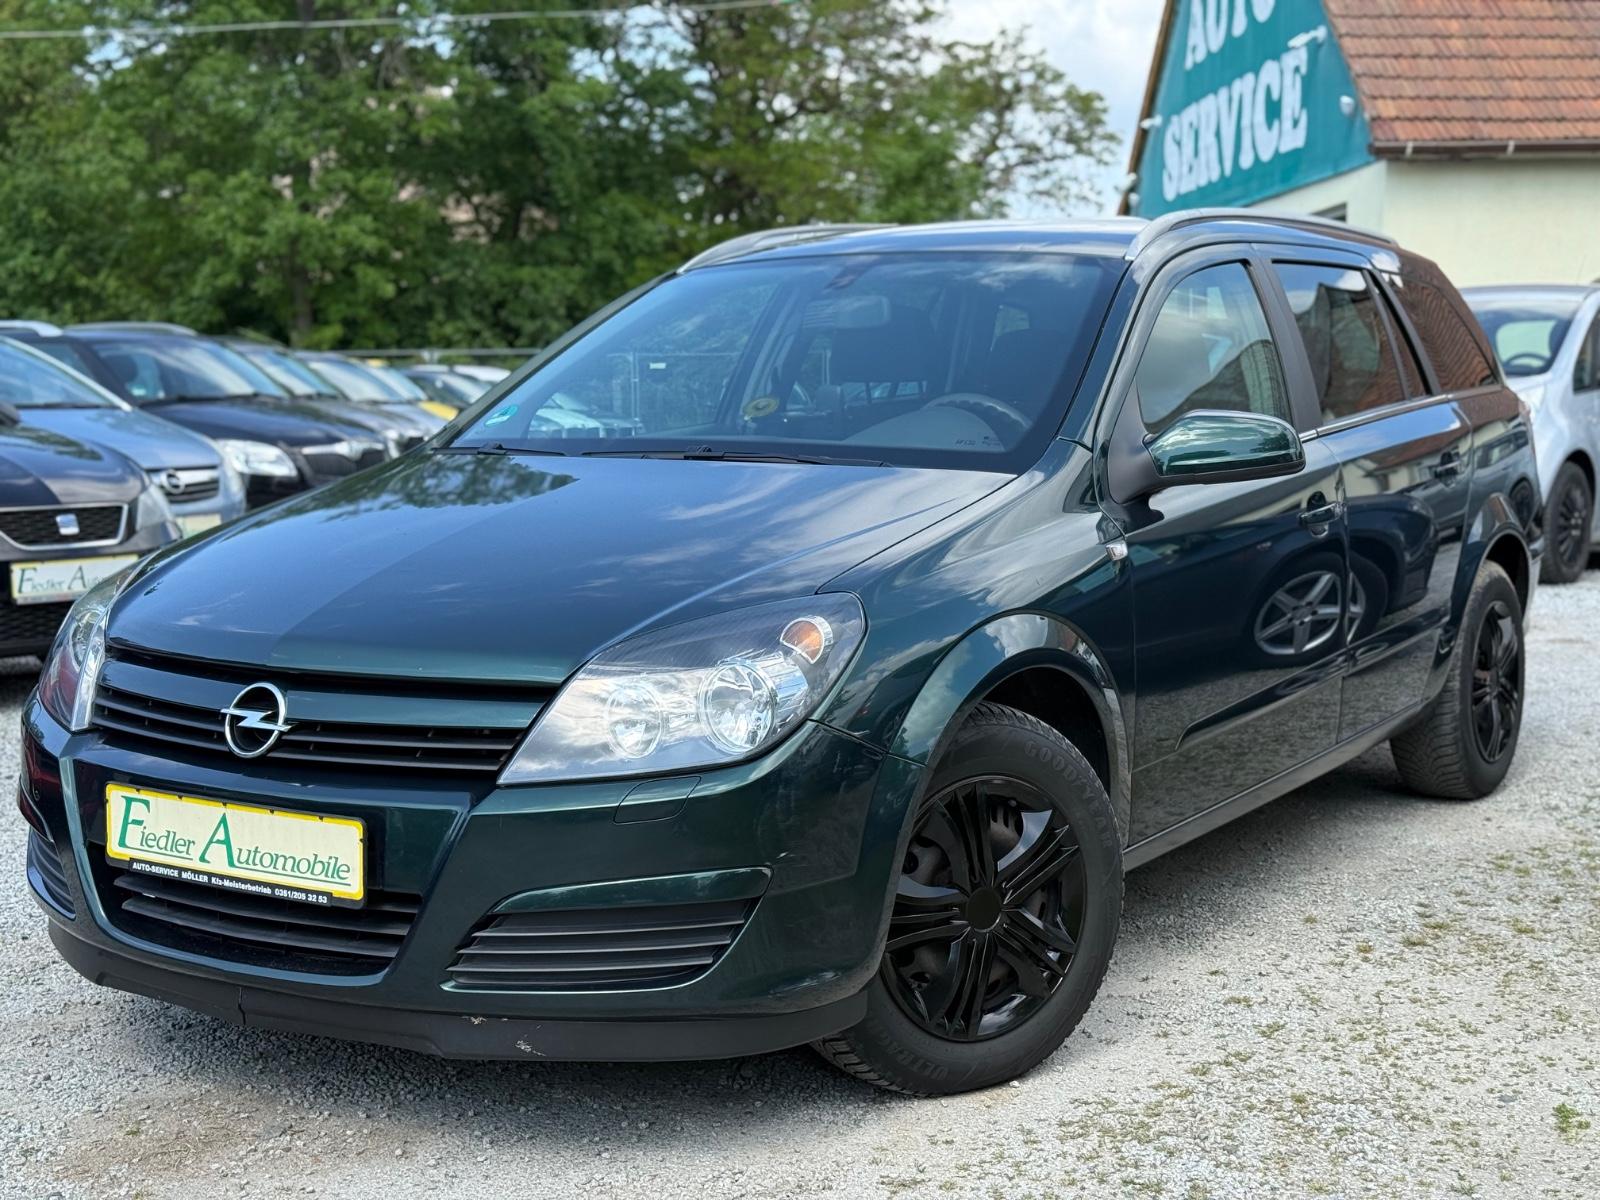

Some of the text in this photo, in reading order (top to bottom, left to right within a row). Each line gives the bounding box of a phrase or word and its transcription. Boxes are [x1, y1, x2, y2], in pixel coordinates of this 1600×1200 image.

[1185, 0, 1275, 70] AU
[1163, 46, 1308, 201] SERVICE
[118, 795, 351, 880] Fiedler Automobile
[132, 862, 328, 904] AUTO-SERVICE MÖLLER Kfz-Meisterbetrieb 0351/205 32 53
